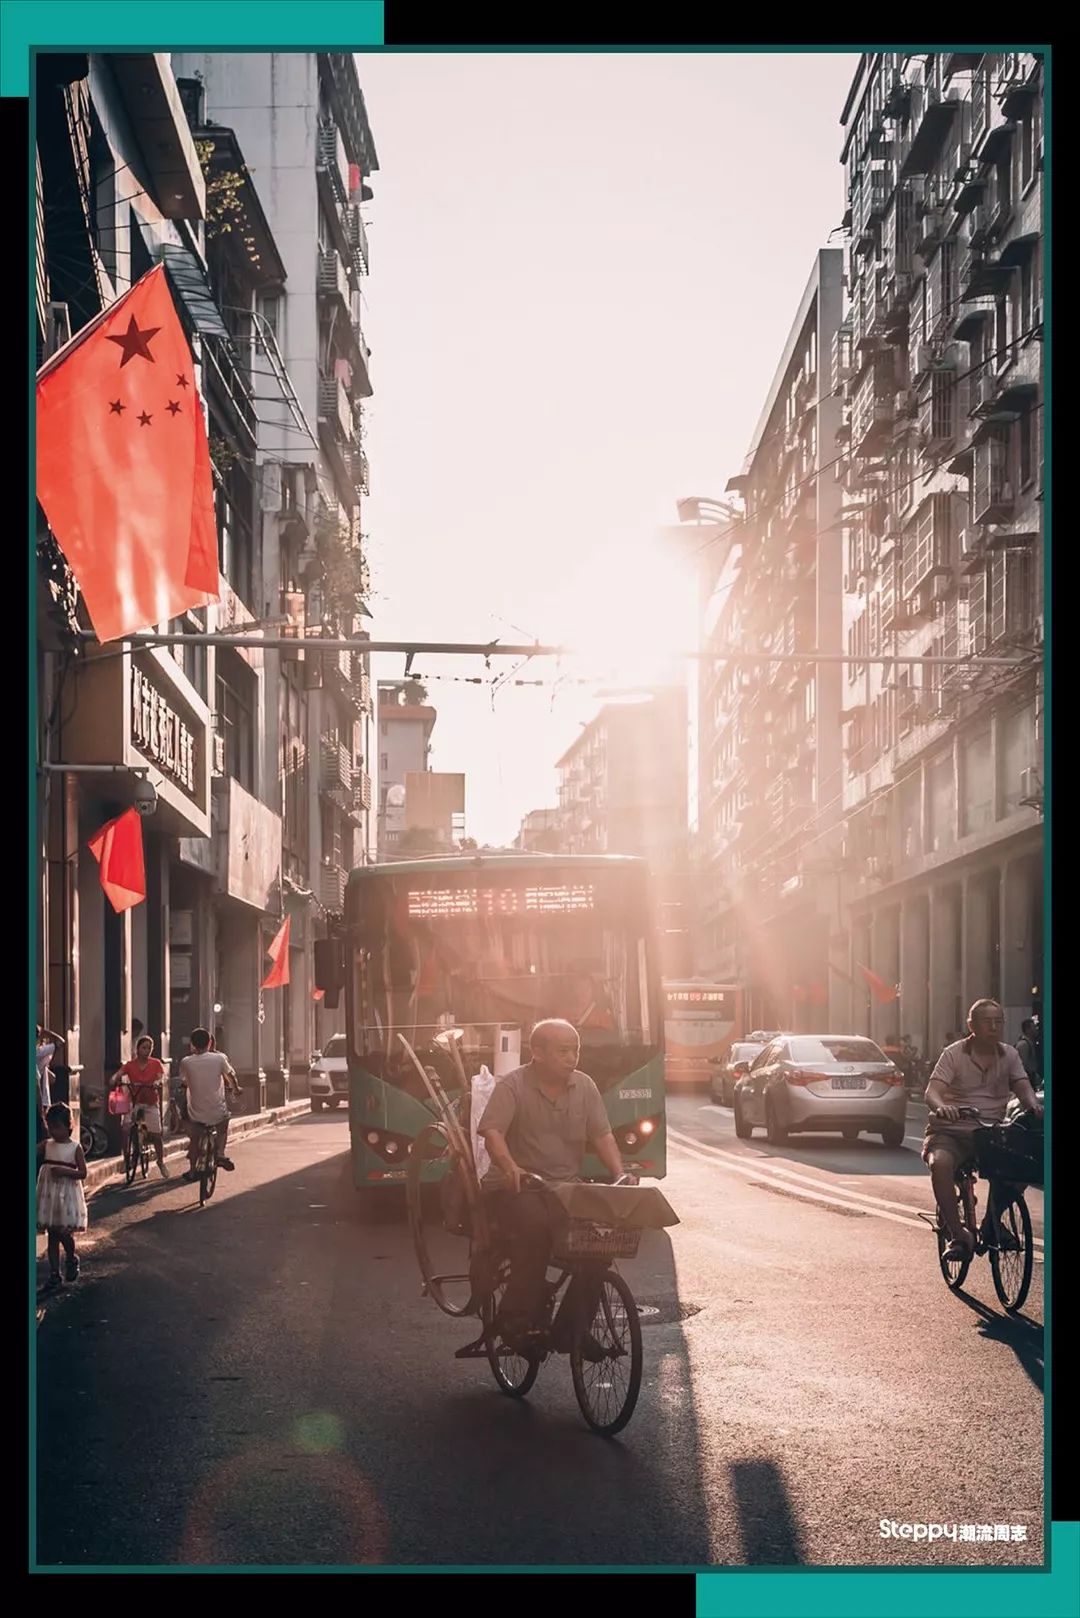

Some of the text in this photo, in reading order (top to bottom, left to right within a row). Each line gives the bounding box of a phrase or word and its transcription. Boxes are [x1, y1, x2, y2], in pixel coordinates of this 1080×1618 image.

[131, 664, 197, 792] 州市越秀区儿童医
